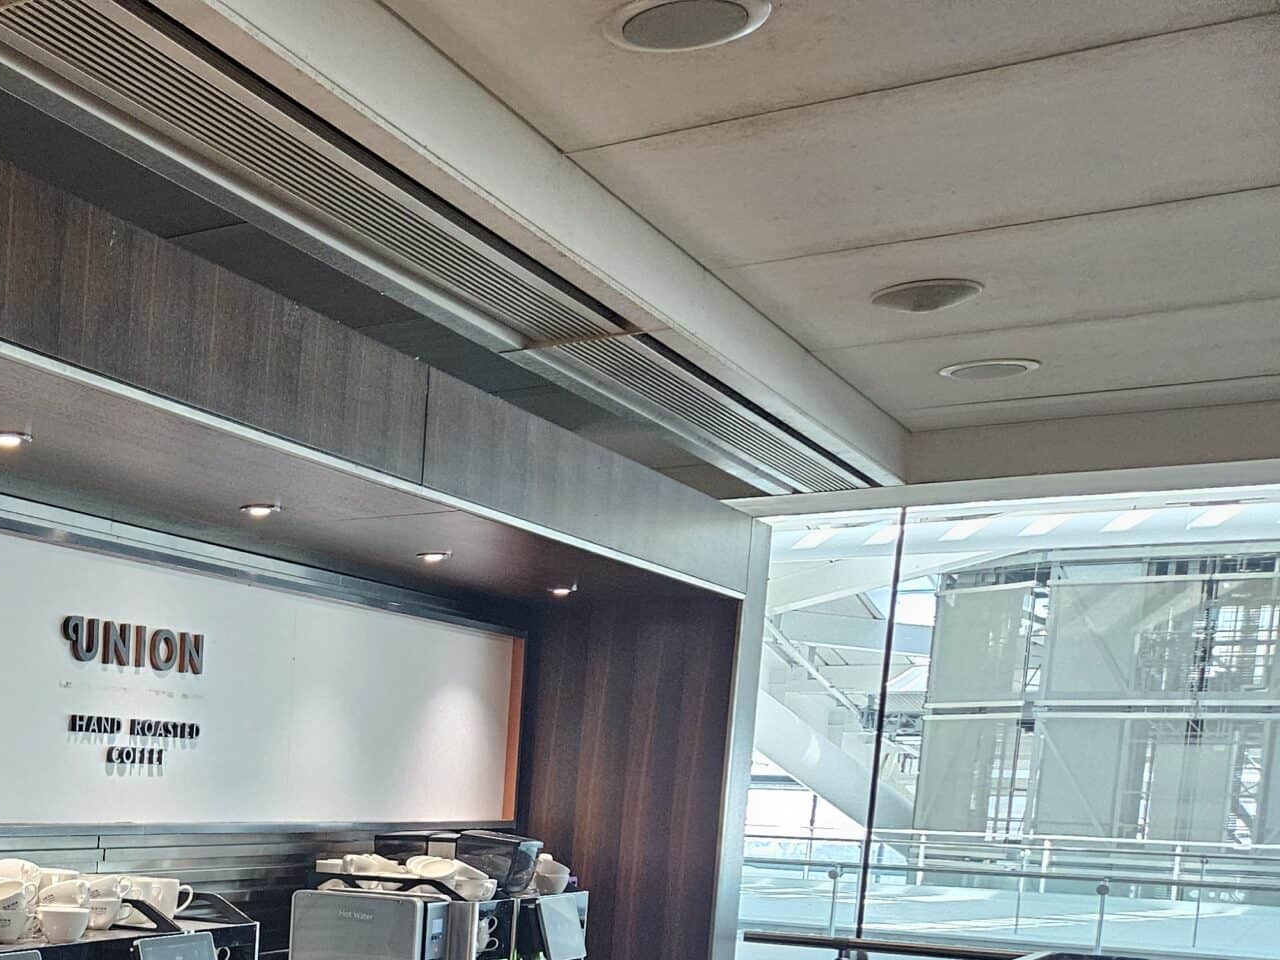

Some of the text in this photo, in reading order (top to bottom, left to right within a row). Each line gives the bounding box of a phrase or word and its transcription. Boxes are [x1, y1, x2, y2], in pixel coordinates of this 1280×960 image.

[62, 615, 205, 675] UNION
[67, 714, 201, 740] HAND ROASTED
